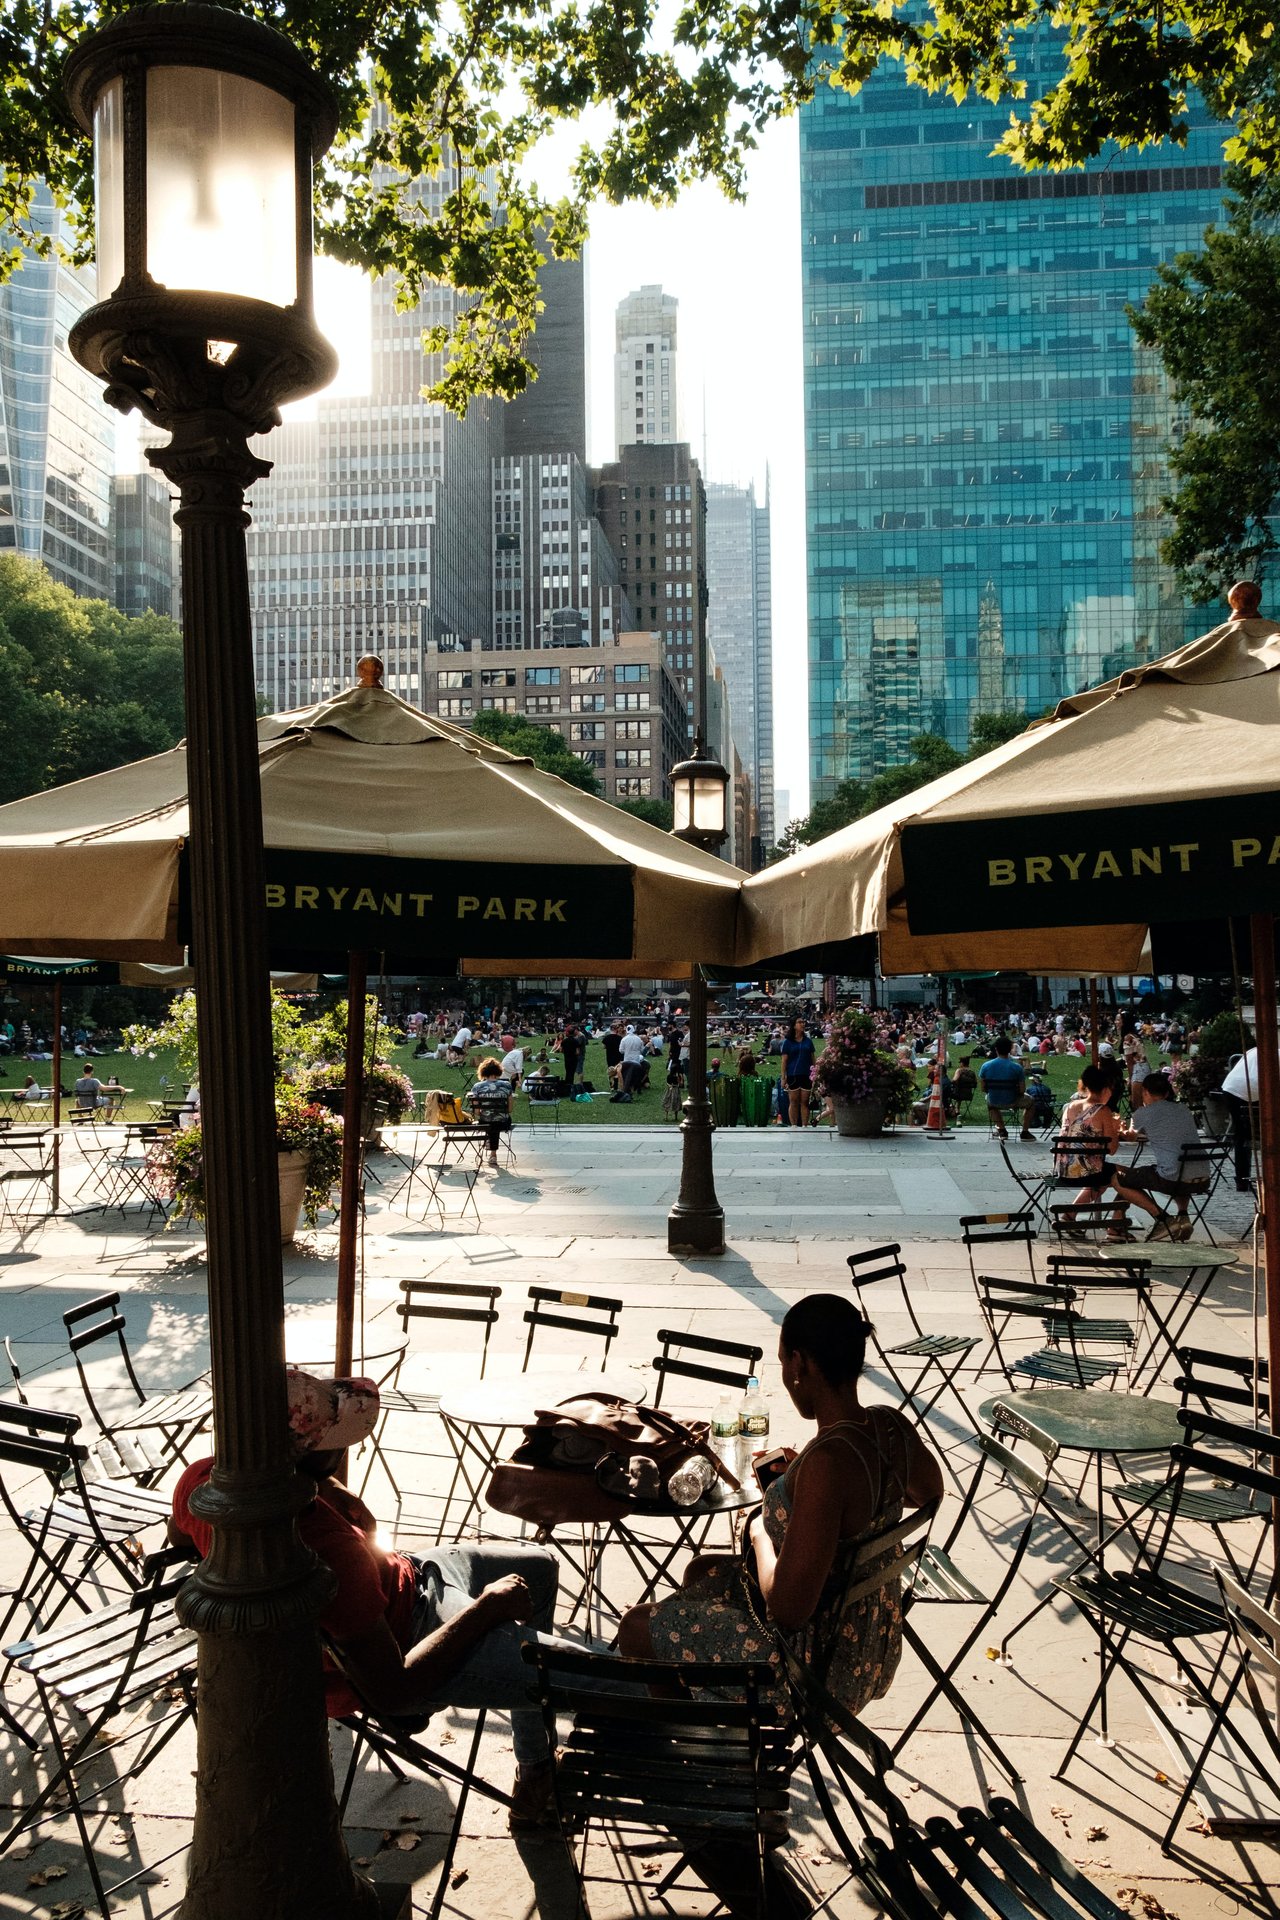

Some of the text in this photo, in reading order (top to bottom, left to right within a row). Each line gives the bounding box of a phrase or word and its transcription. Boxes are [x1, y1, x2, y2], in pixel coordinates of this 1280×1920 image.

[988, 843, 1199, 886] BRYANT
[265, 884, 567, 922] BRYANT PARK
[7, 964, 98, 975] BRYANT PARK
